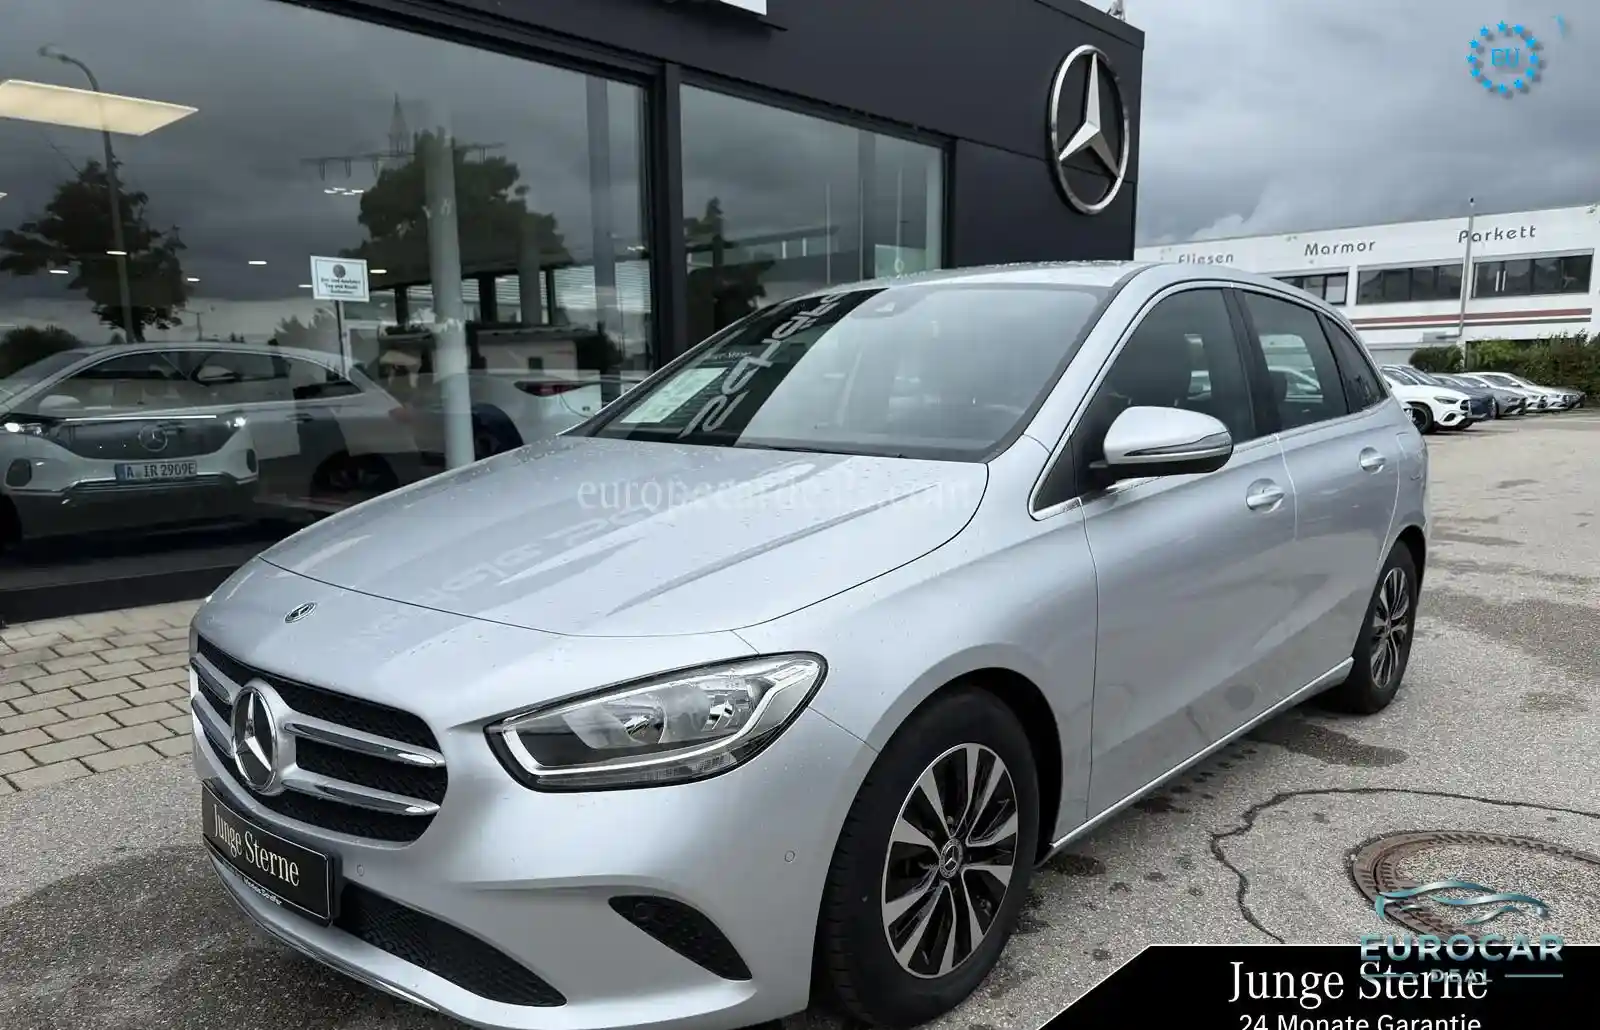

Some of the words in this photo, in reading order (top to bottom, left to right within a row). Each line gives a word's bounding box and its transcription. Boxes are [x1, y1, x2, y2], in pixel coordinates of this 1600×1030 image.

[1177, 252, 1234, 265] Fliesen
[1304, 240, 1376, 256] Marmor
[1458, 225, 1536, 243] Parkett
[127, 466, 135, 479] A
[144, 464, 158, 478] IR
[160, 462, 196, 476] 2909E
[211, 803, 243, 858] Junge
[245, 830, 300, 887] Sterne
